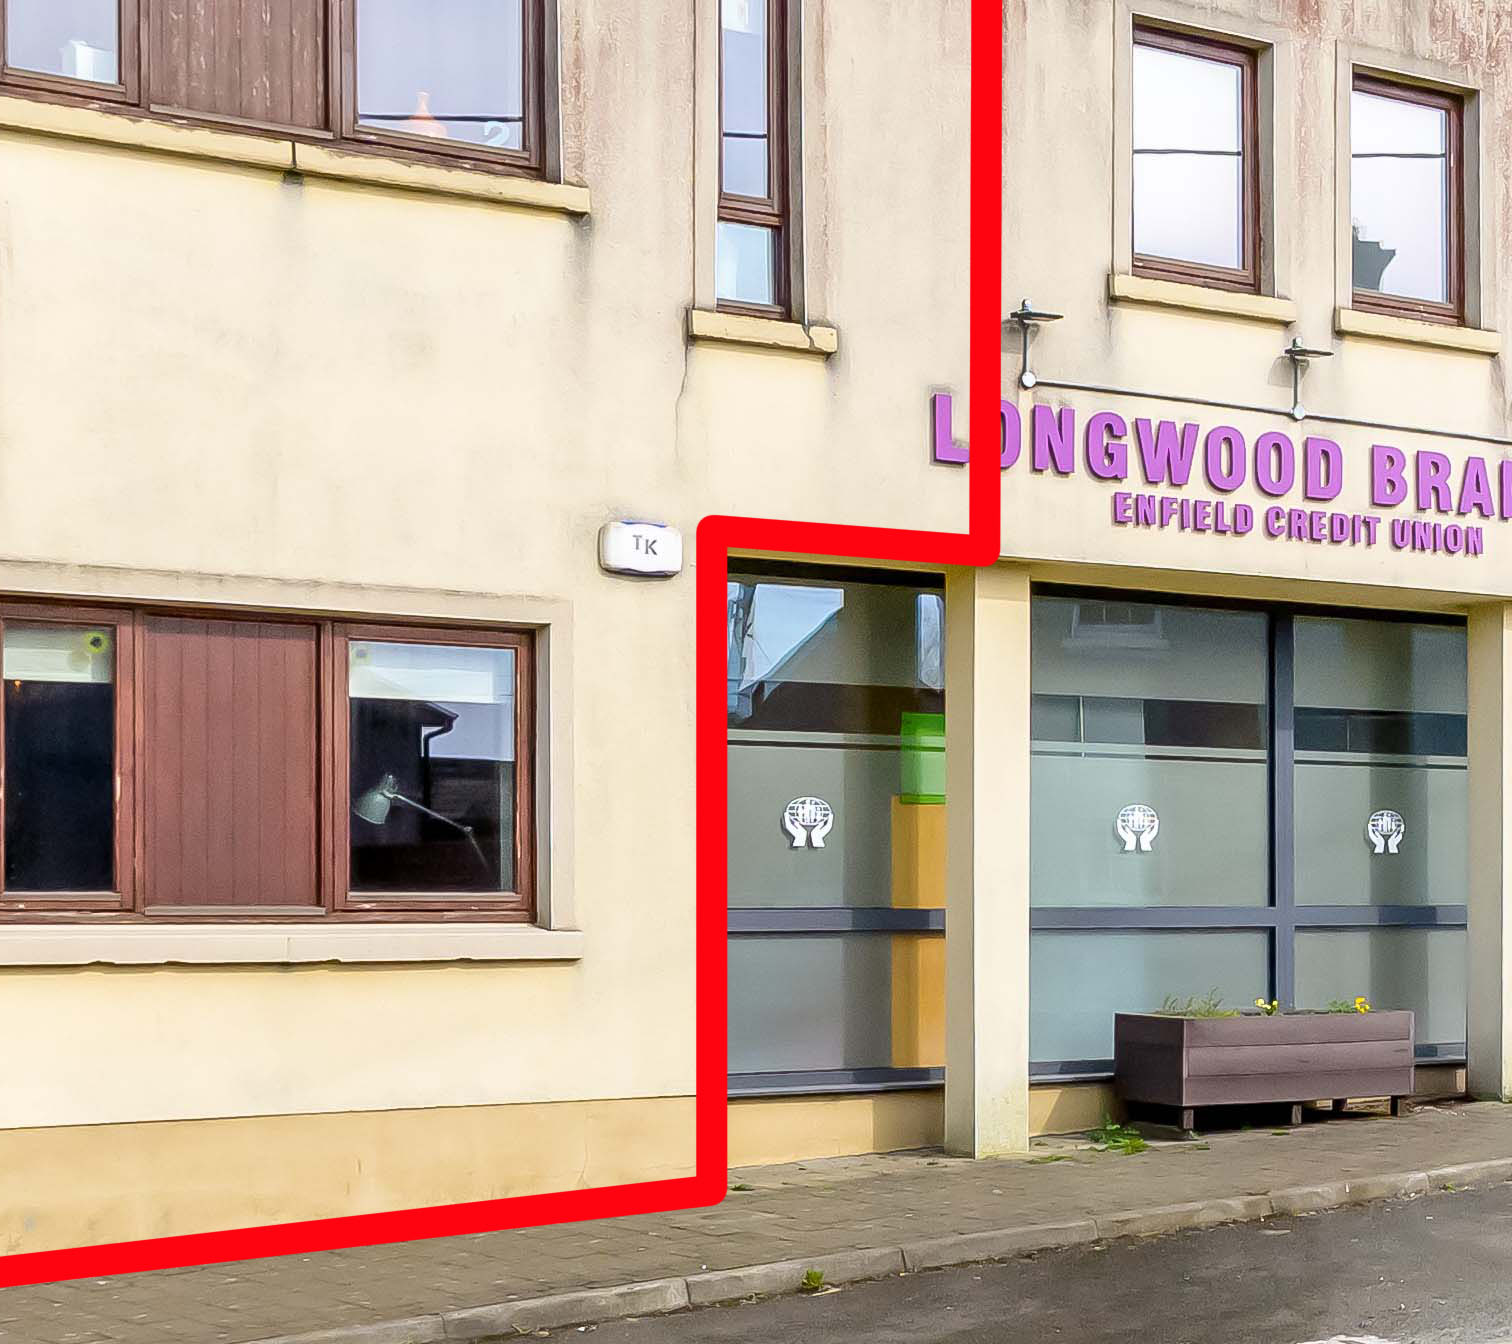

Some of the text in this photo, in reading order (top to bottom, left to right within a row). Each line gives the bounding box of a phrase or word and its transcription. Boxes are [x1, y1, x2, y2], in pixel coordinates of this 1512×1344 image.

[932, 392, 1344, 502] LONGWOOD
[1113, 491, 1484, 556] ENFIELD CREDIT UNION
